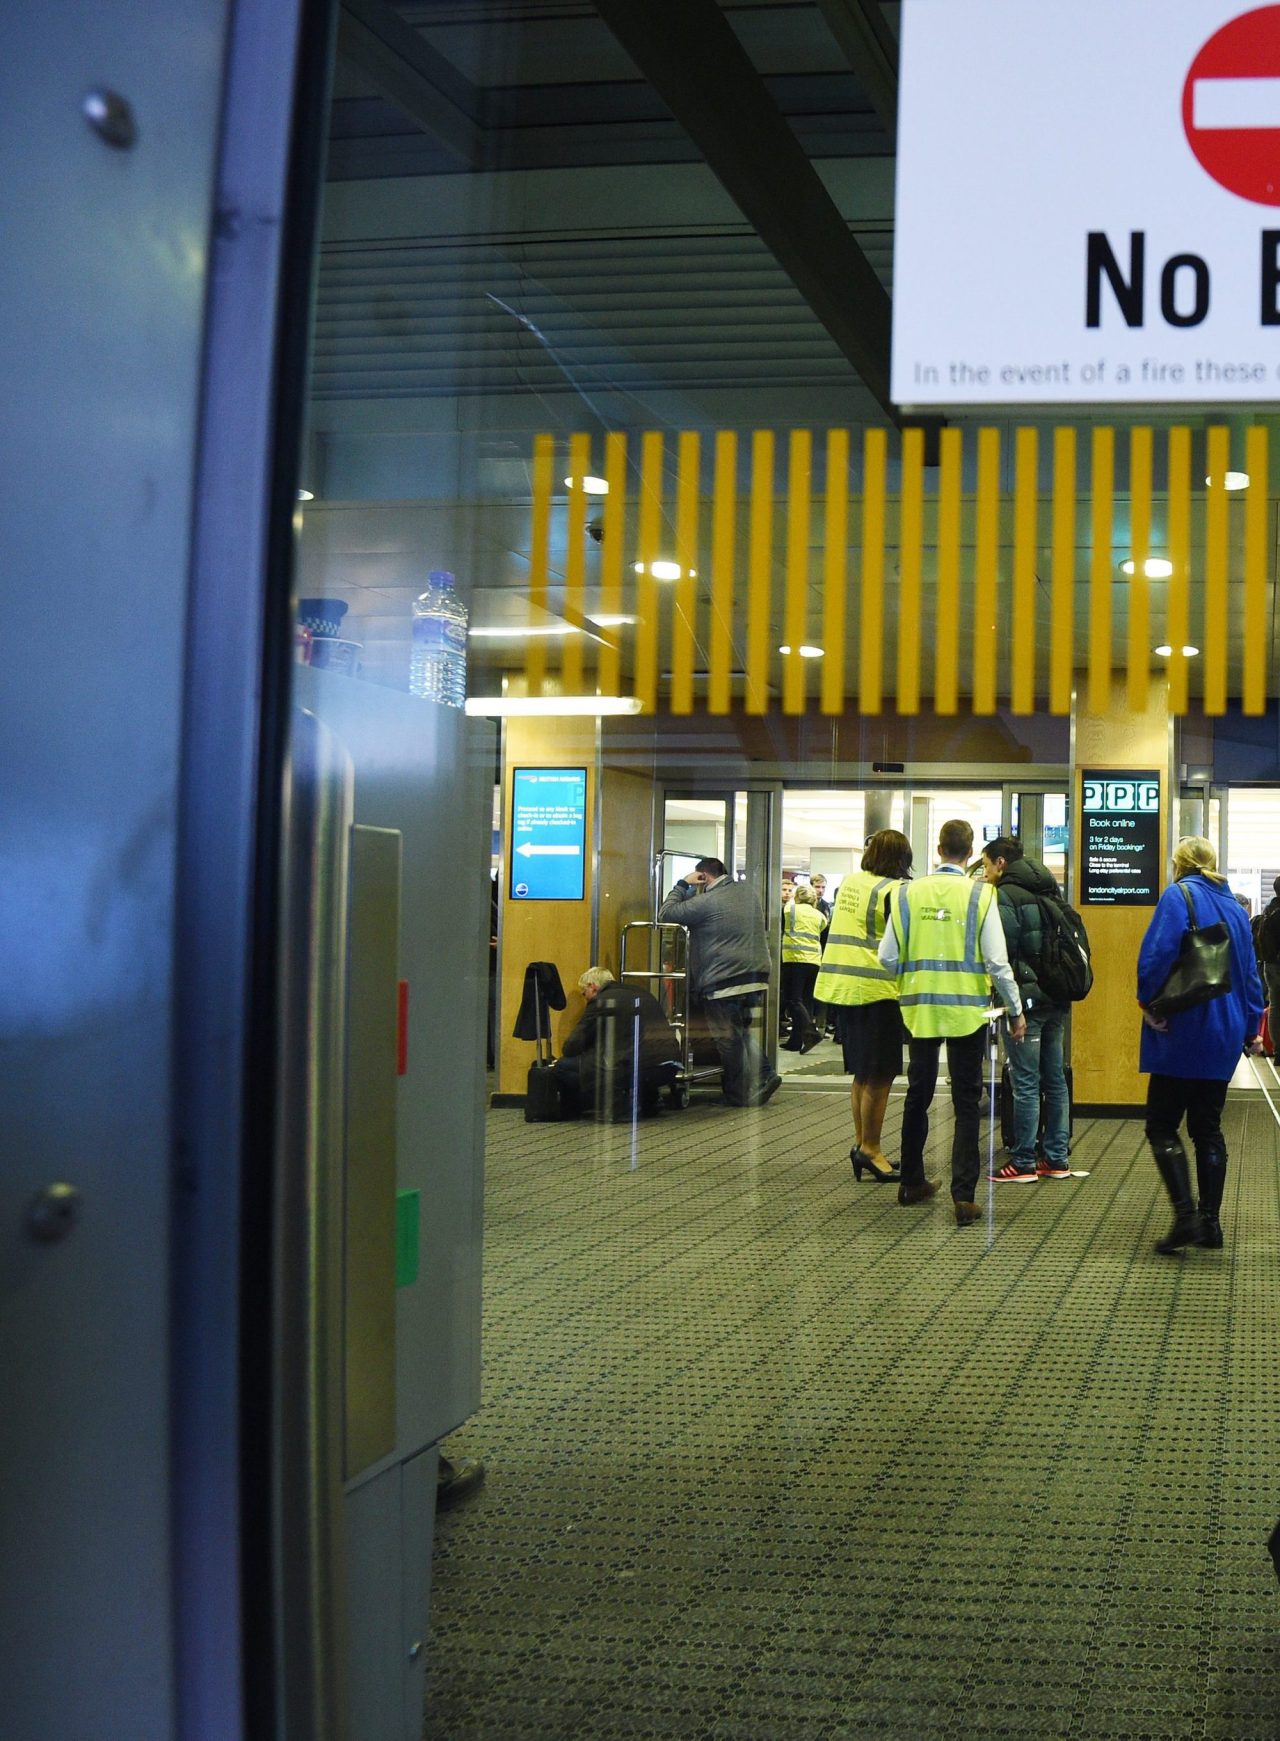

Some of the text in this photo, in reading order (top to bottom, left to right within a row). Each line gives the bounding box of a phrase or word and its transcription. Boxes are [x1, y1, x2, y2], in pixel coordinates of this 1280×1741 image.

[1084, 230, 1212, 329] No
[914, 362, 939, 385] In
[949, 360, 991, 386] the
[1002, 361, 1071, 387] event
[1080, 359, 1107, 384] of
[1115, 364, 1132, 384] a
[1142, 357, 1186, 384] fire
[1195, 357, 1267, 384] these
[1114, 787, 1128, 807] P
[1089, 818, 1136, 828] Book online
[1089, 835, 1095, 843] 3
[1109, 836, 1124, 844] days
[1097, 844, 1116, 852] Friday
[1088, 886, 1150, 895] londoncityairport.com
